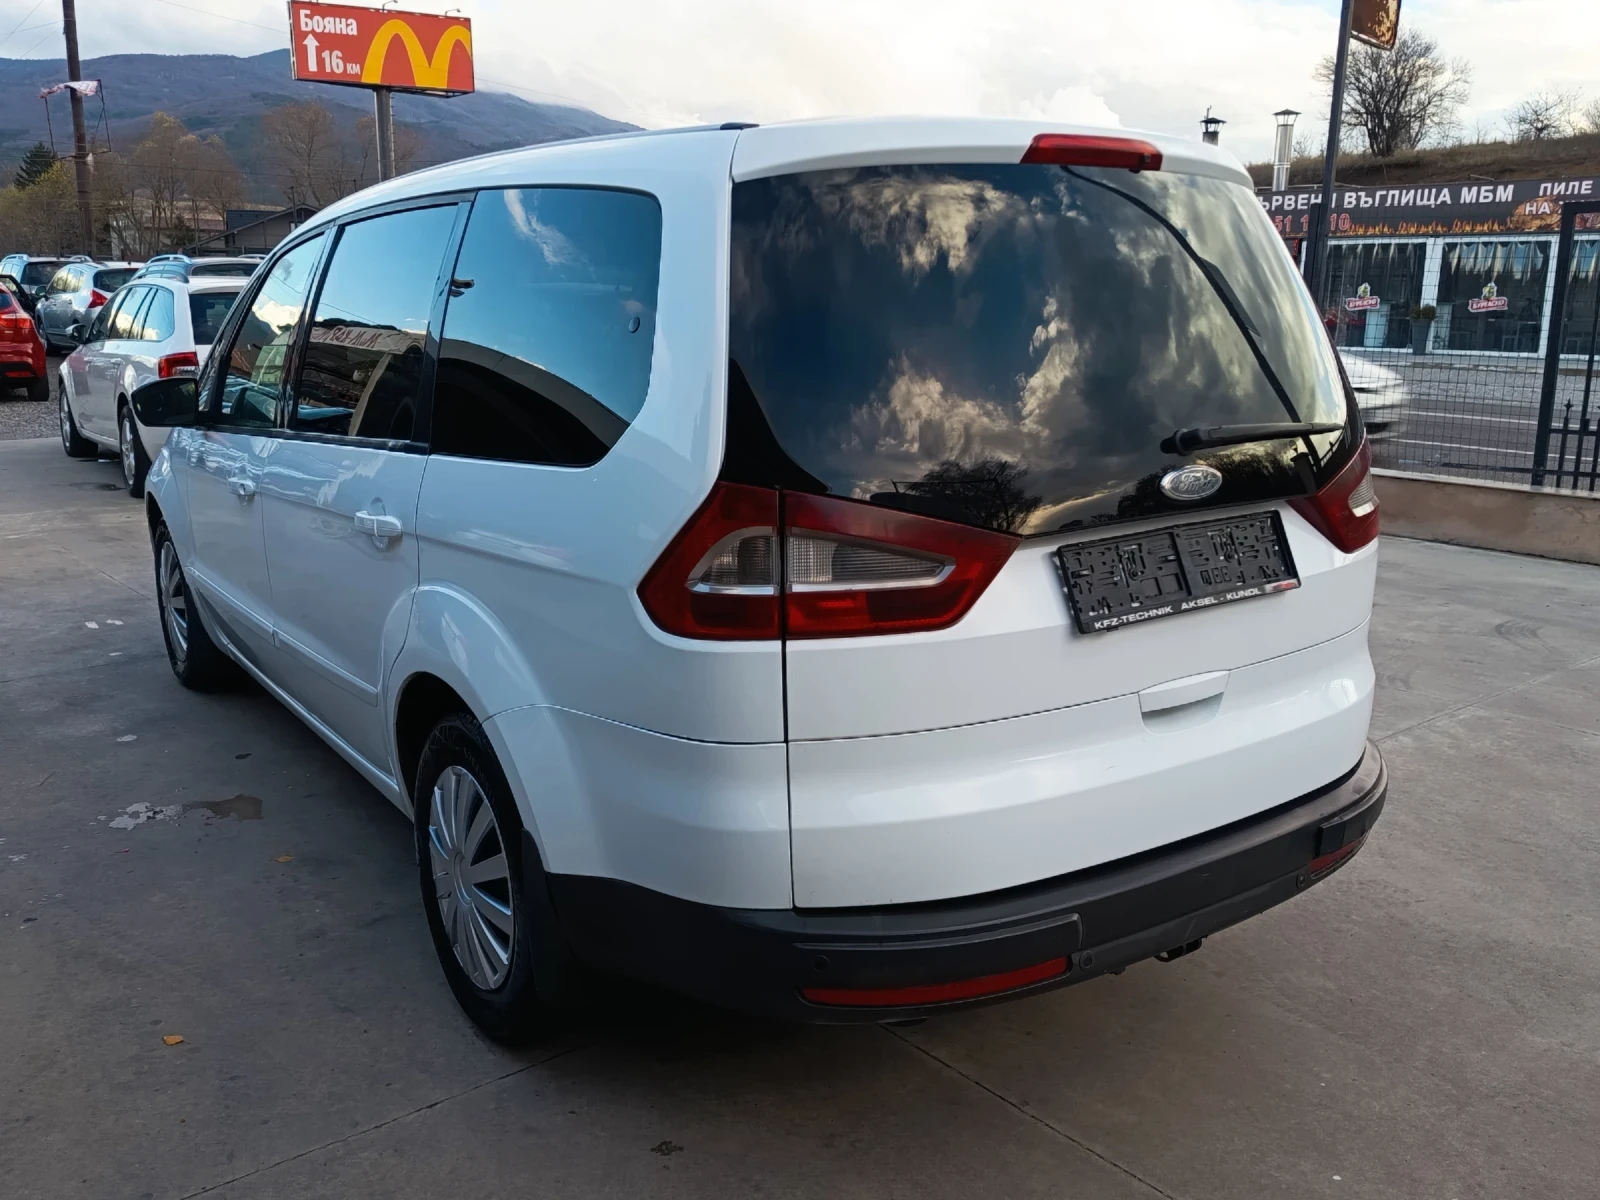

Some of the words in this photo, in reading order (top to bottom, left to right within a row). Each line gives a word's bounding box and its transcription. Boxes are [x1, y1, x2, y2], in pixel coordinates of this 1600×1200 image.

[300, 9, 358, 36] Бояна
[321, 50, 345, 75] 16
[1343, 187, 1452, 209] ВЪГЛИЩА
[1459, 184, 1515, 204] МБМ
[1538, 180, 1594, 197] ПИЛЕ
[1525, 201, 1551, 216] НА
[1330, 213, 1350, 231] 10
[1094, 605, 1174, 630] KFZ-TECHNIK
[1181, 596, 1218, 611] AKSEL
[1226, 587, 1262, 601] KUNDL
